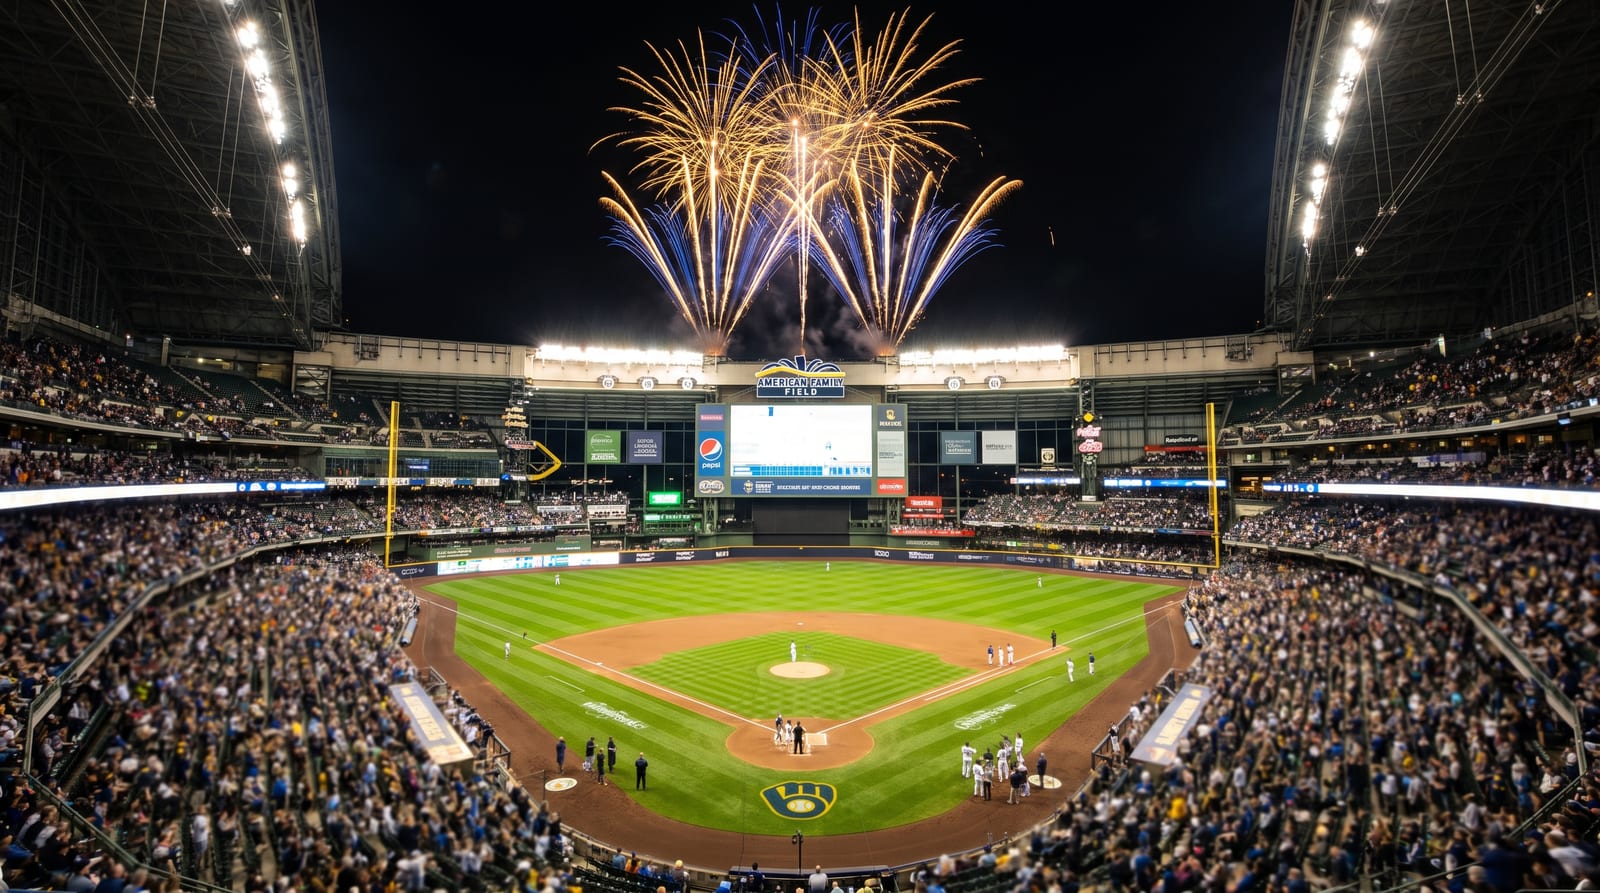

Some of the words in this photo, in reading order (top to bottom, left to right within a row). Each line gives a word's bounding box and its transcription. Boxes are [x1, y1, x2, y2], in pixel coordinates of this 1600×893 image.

[757, 378, 808, 387] AMERICAN
[810, 378, 844, 387] FAMILY
[784, 388, 818, 396] FIELD
[702, 461, 721, 470] pepsi
